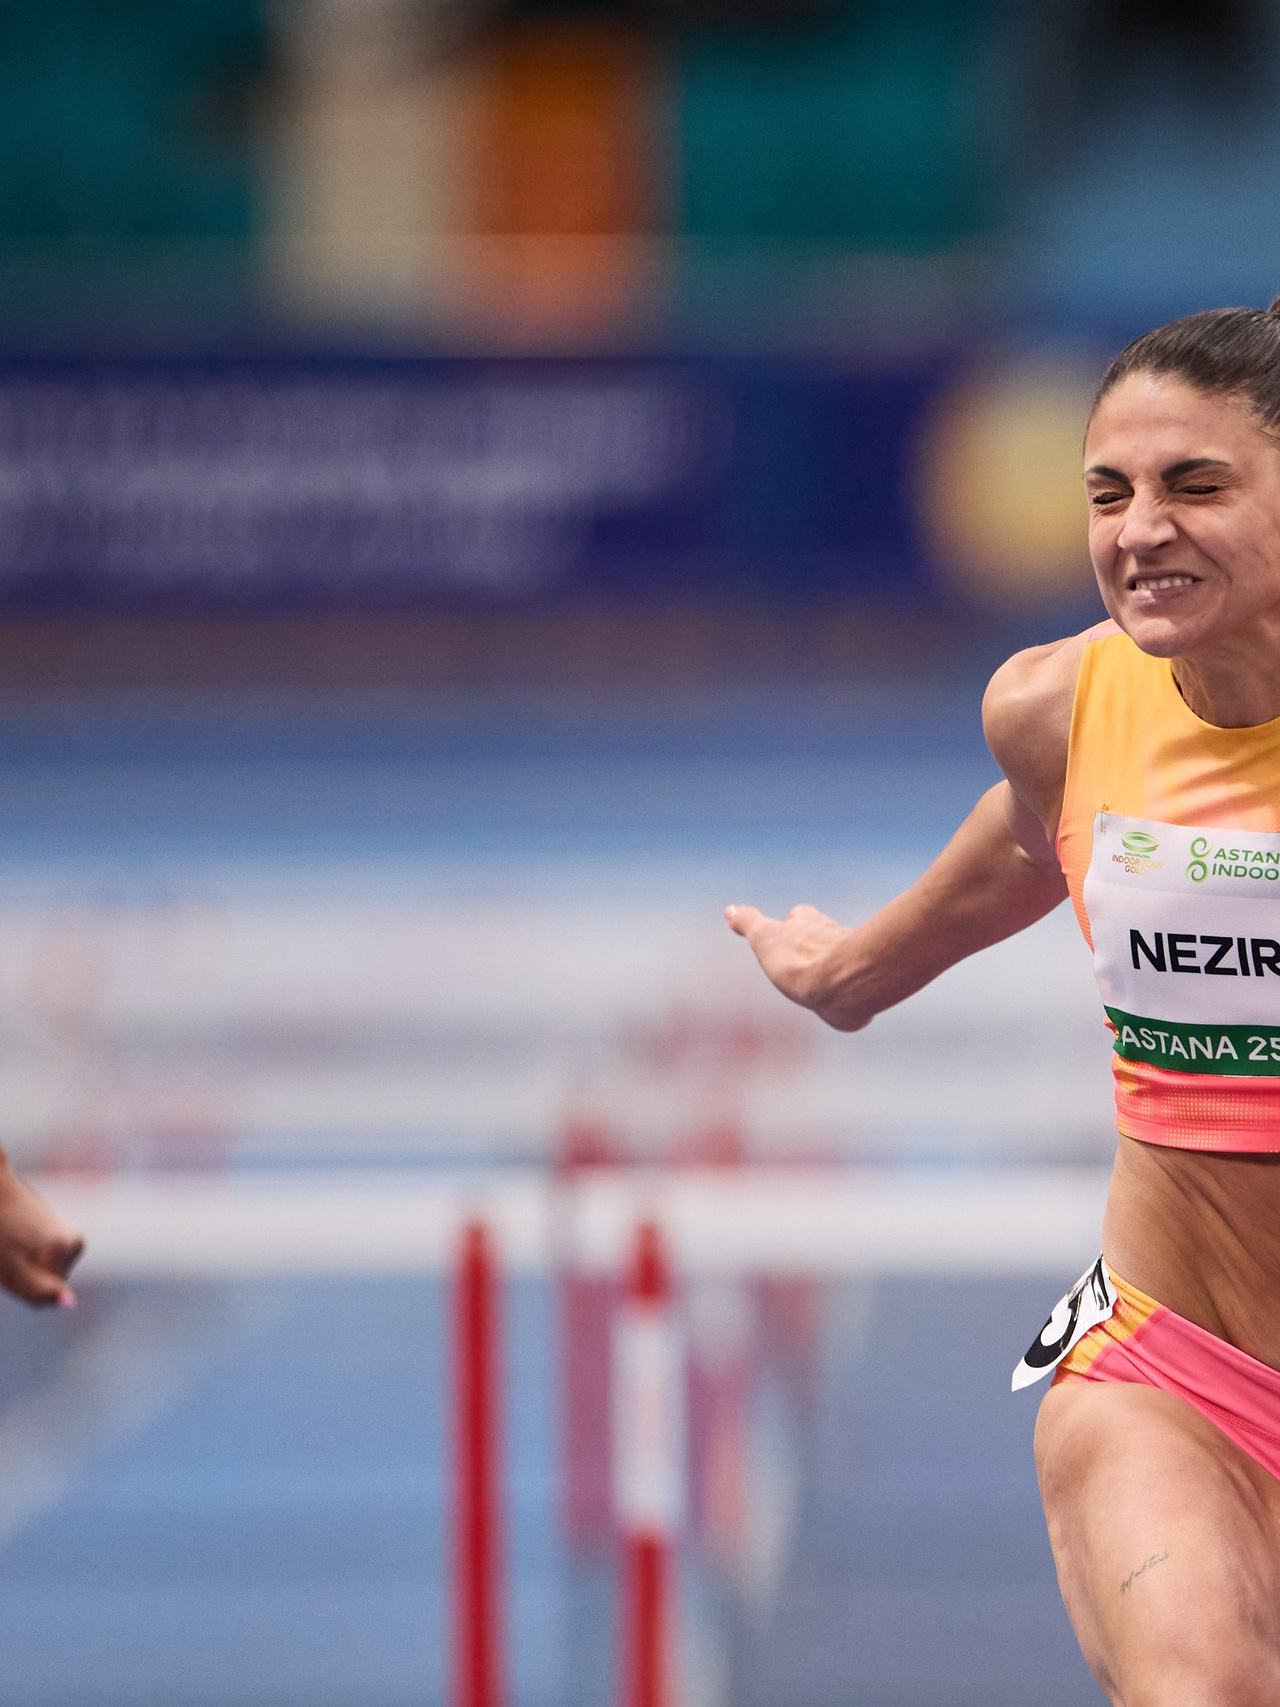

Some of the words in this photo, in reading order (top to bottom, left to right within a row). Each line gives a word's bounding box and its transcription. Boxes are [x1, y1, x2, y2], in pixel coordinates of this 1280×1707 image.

[1112, 854, 1141, 866] INDOOR
[1125, 865, 1147, 876] GOLD
[1121, 1025, 1238, 1060] ASTANA
